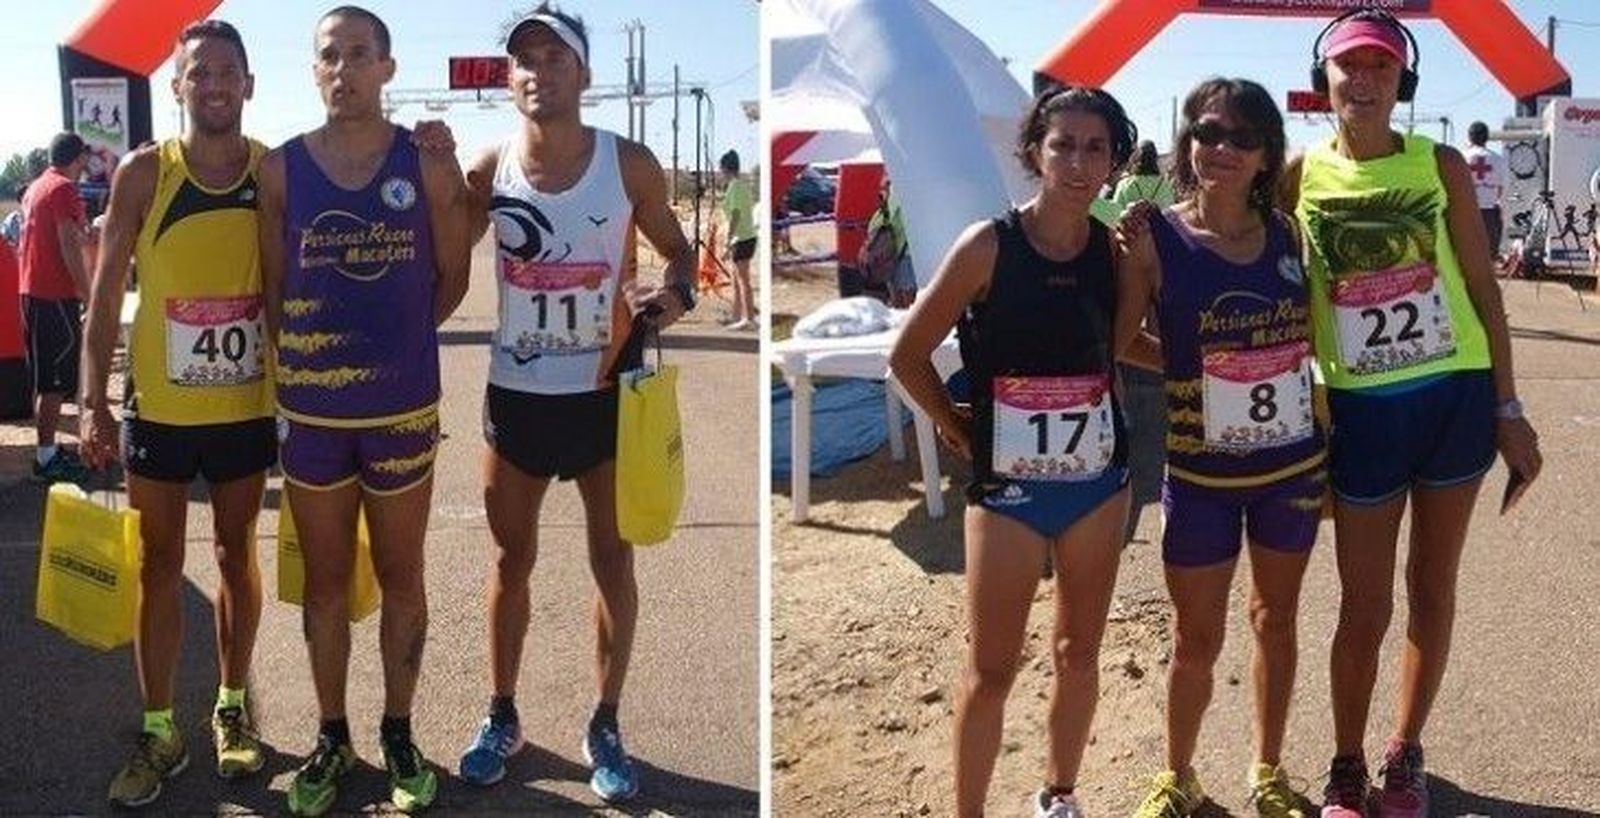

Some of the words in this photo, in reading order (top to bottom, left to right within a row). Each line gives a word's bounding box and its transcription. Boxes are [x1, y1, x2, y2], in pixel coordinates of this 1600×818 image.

[532, 293, 577, 330] 11
[1361, 301, 1424, 348] 22
[192, 326, 246, 362] 40
[1249, 383, 1278, 423] 8
[1028, 412, 1088, 455] 17
